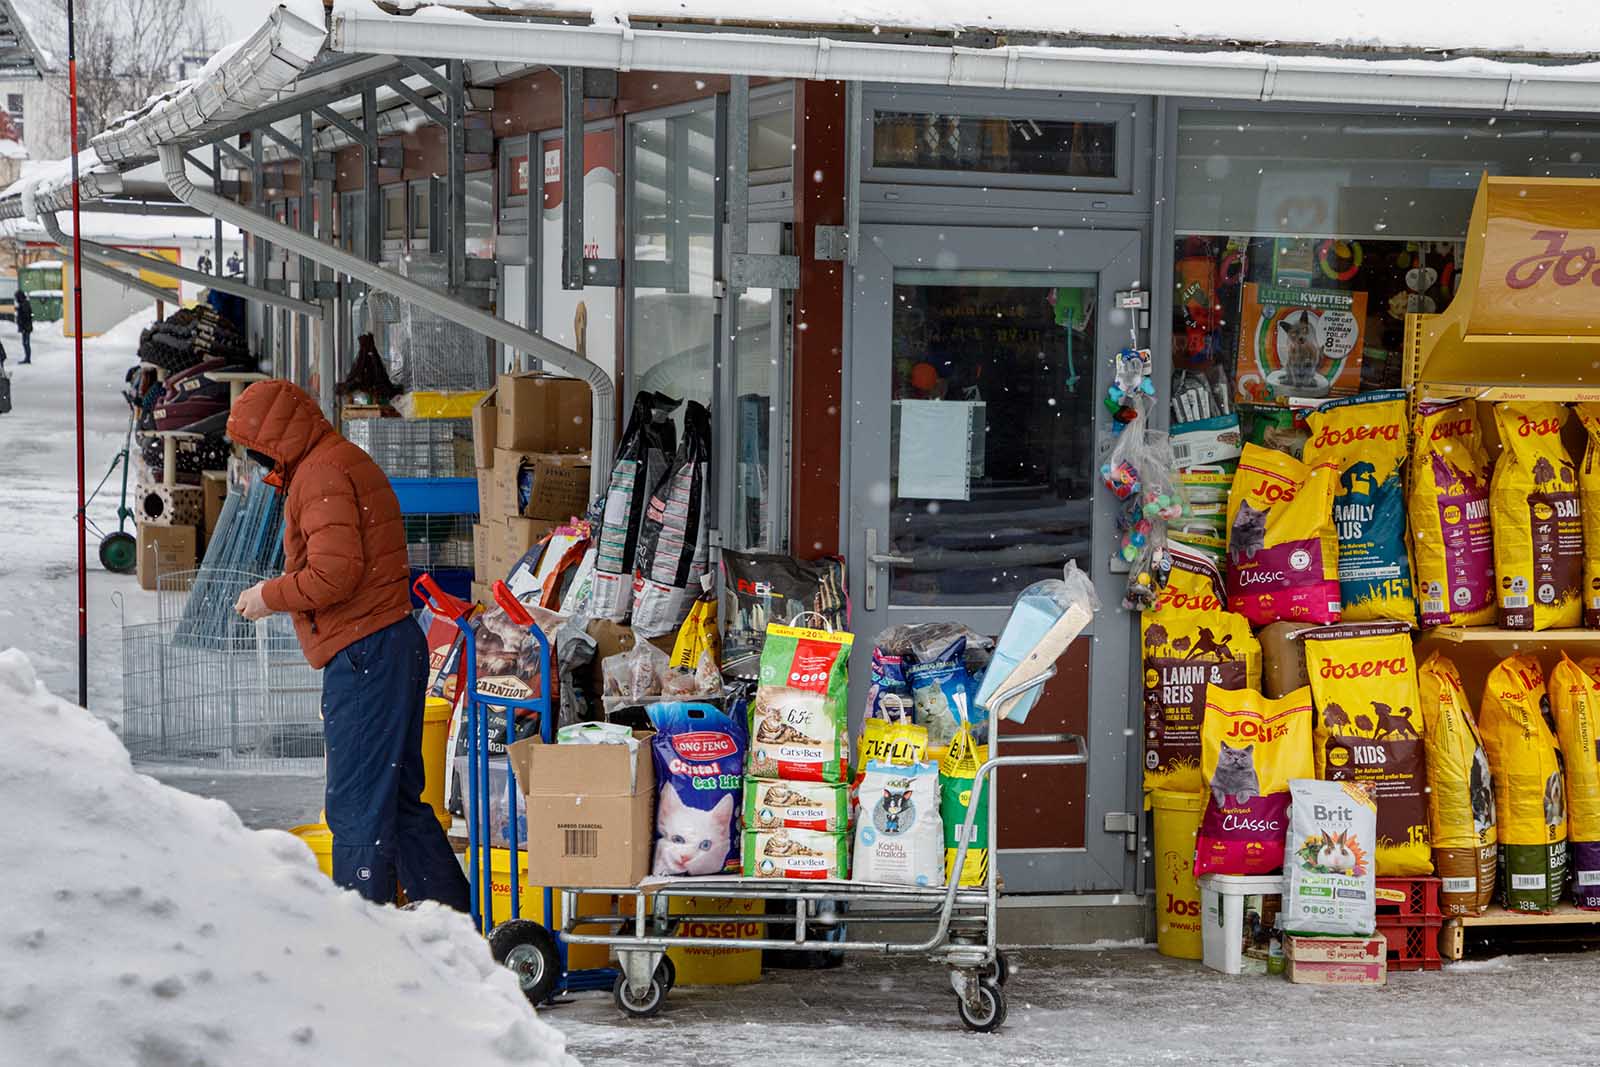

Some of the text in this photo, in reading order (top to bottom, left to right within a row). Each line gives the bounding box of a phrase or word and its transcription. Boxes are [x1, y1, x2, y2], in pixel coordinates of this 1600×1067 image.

[1505, 230, 1600, 289] Jo
[1300, 292, 1352, 304] KWITTER
[1325, 337, 1334, 348] 8
[1314, 424, 1399, 448] Josera
[1335, 504, 1375, 521] AMILY
[1338, 522, 1362, 540] LUS
[1239, 569, 1285, 586] CLASSIC
[1156, 583, 1221, 612] Joser
[1163, 665, 1223, 685] LAMM &
[1320, 657, 1408, 679] Josera
[1163, 685, 1194, 704] REIS
[1227, 721, 1272, 743] JOSI
[675, 741, 728, 751] LONG FENG
[780, 747, 822, 758] Cat's Best
[1353, 746, 1386, 765] KIDS
[669, 758, 720, 776] Cristal
[693, 776, 716, 790] Cat
[807, 809, 824, 817] Best
[1313, 804, 1352, 821] Brit
[1223, 815, 1280, 832] CLASSIC
[1407, 824, 1423, 846] 15
[808, 858, 825, 866] Best
[876, 849, 906, 858] kraikas
[1166, 893, 1201, 917] Jos
[1169, 921, 1201, 932] www.jo
